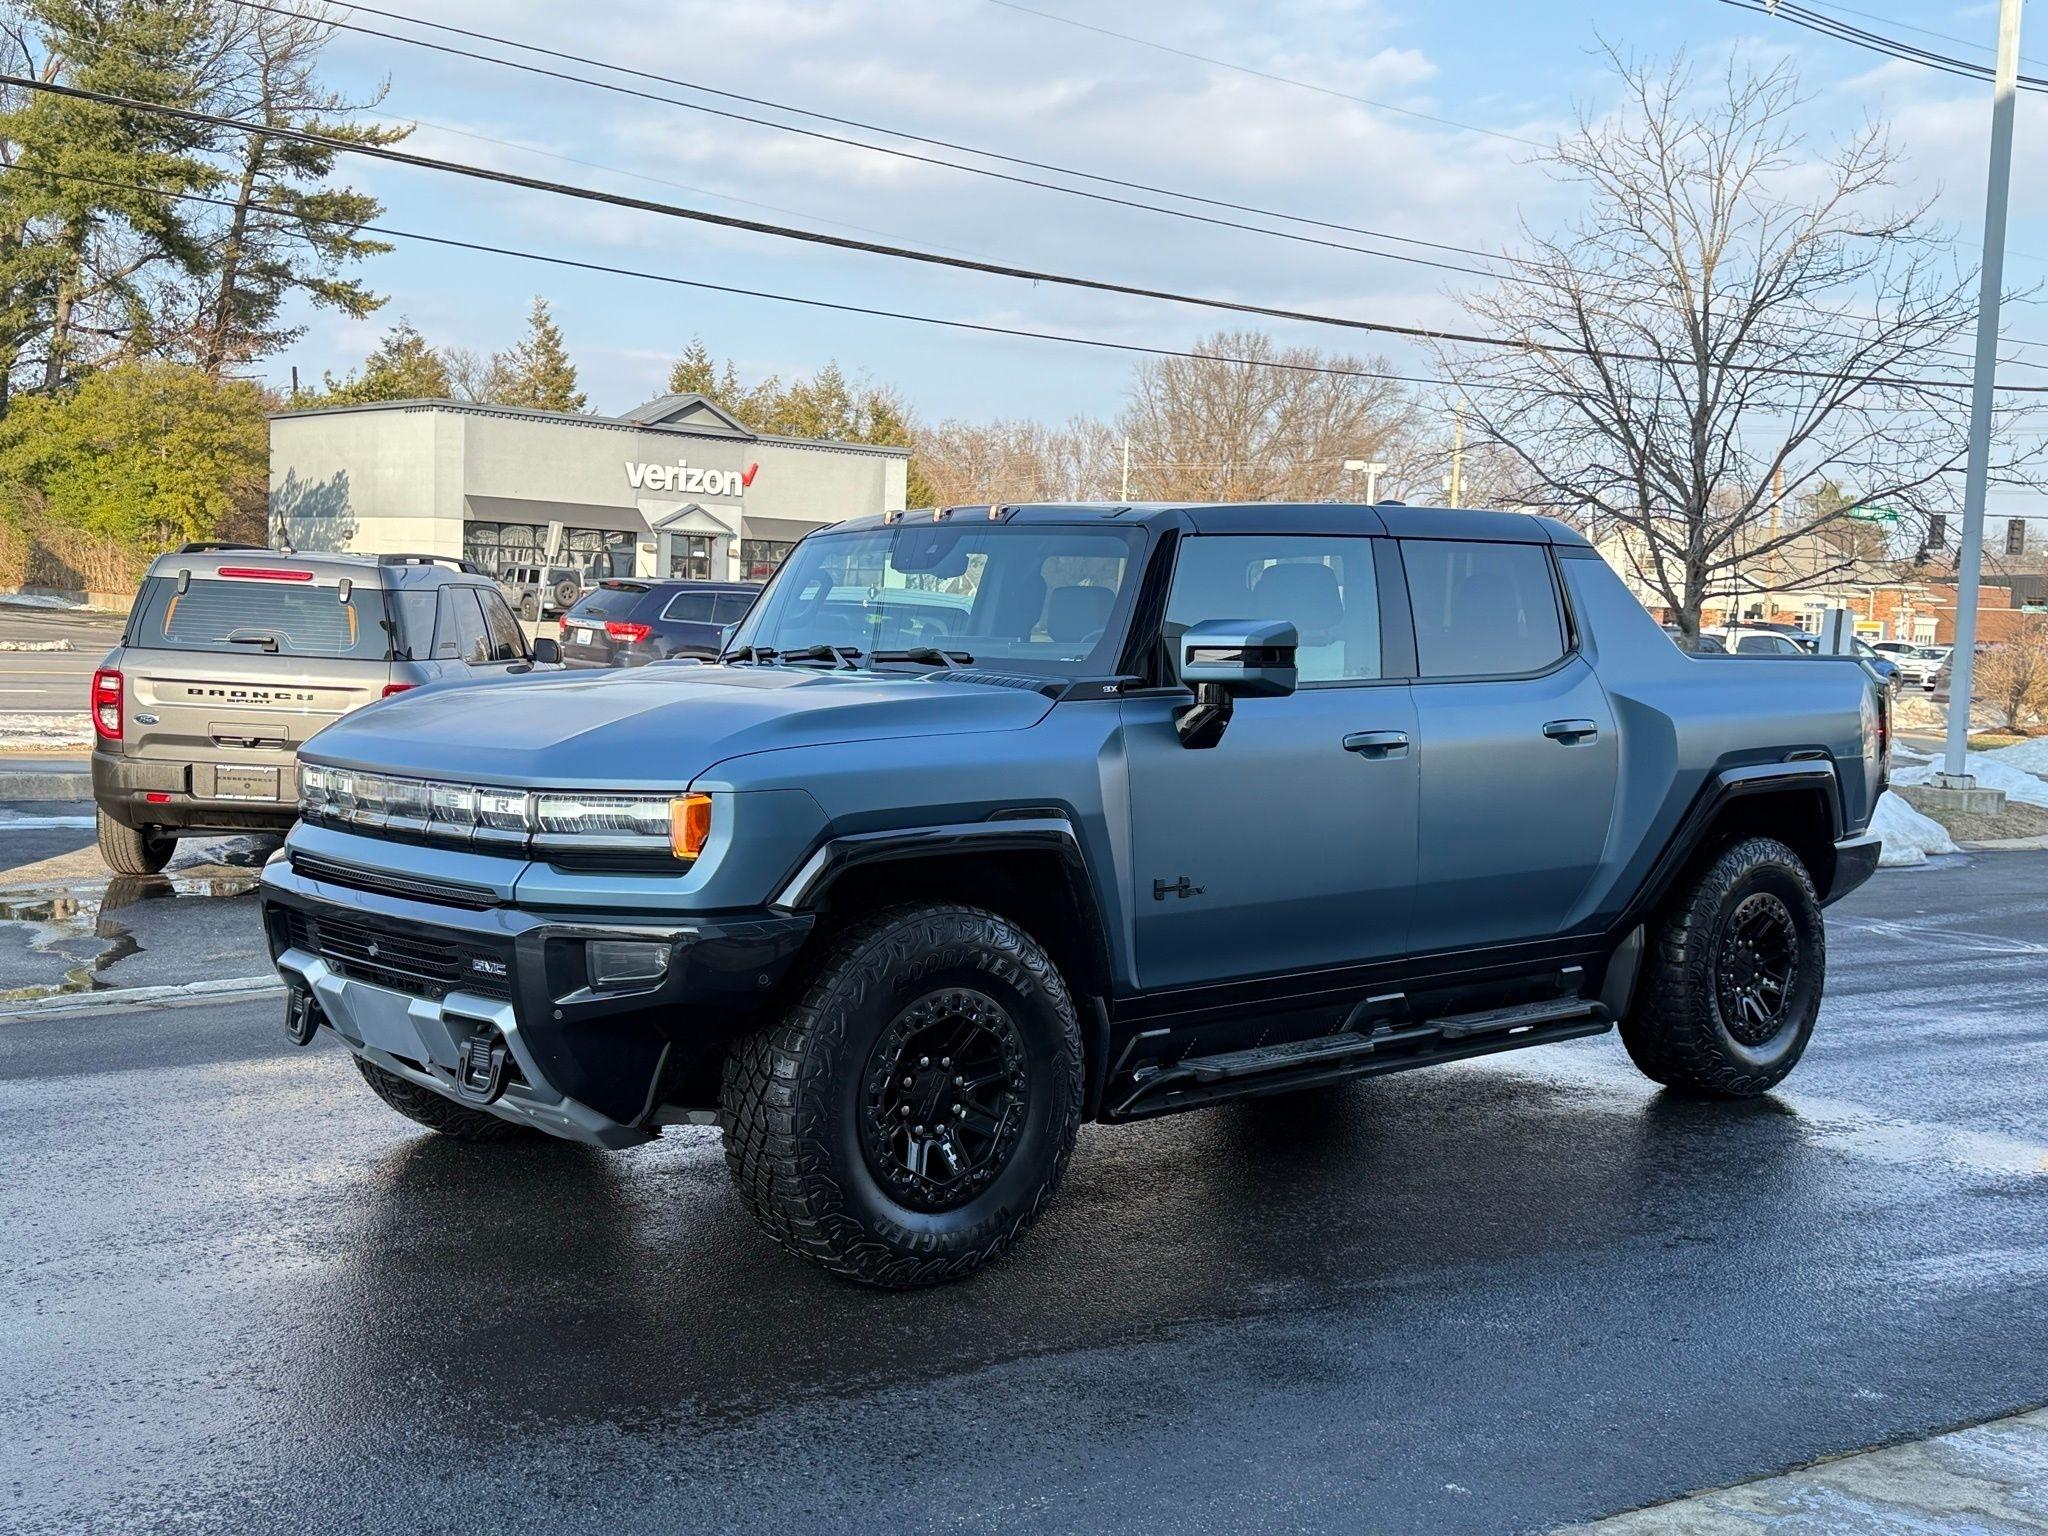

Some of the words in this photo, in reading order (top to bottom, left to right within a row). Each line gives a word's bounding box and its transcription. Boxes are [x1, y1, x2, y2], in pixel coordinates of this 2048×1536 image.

[624, 459, 743, 497] verizon
[188, 688, 313, 701] BRONCO
[309, 772, 511, 812] HUER
[472, 959, 507, 976] GMC
